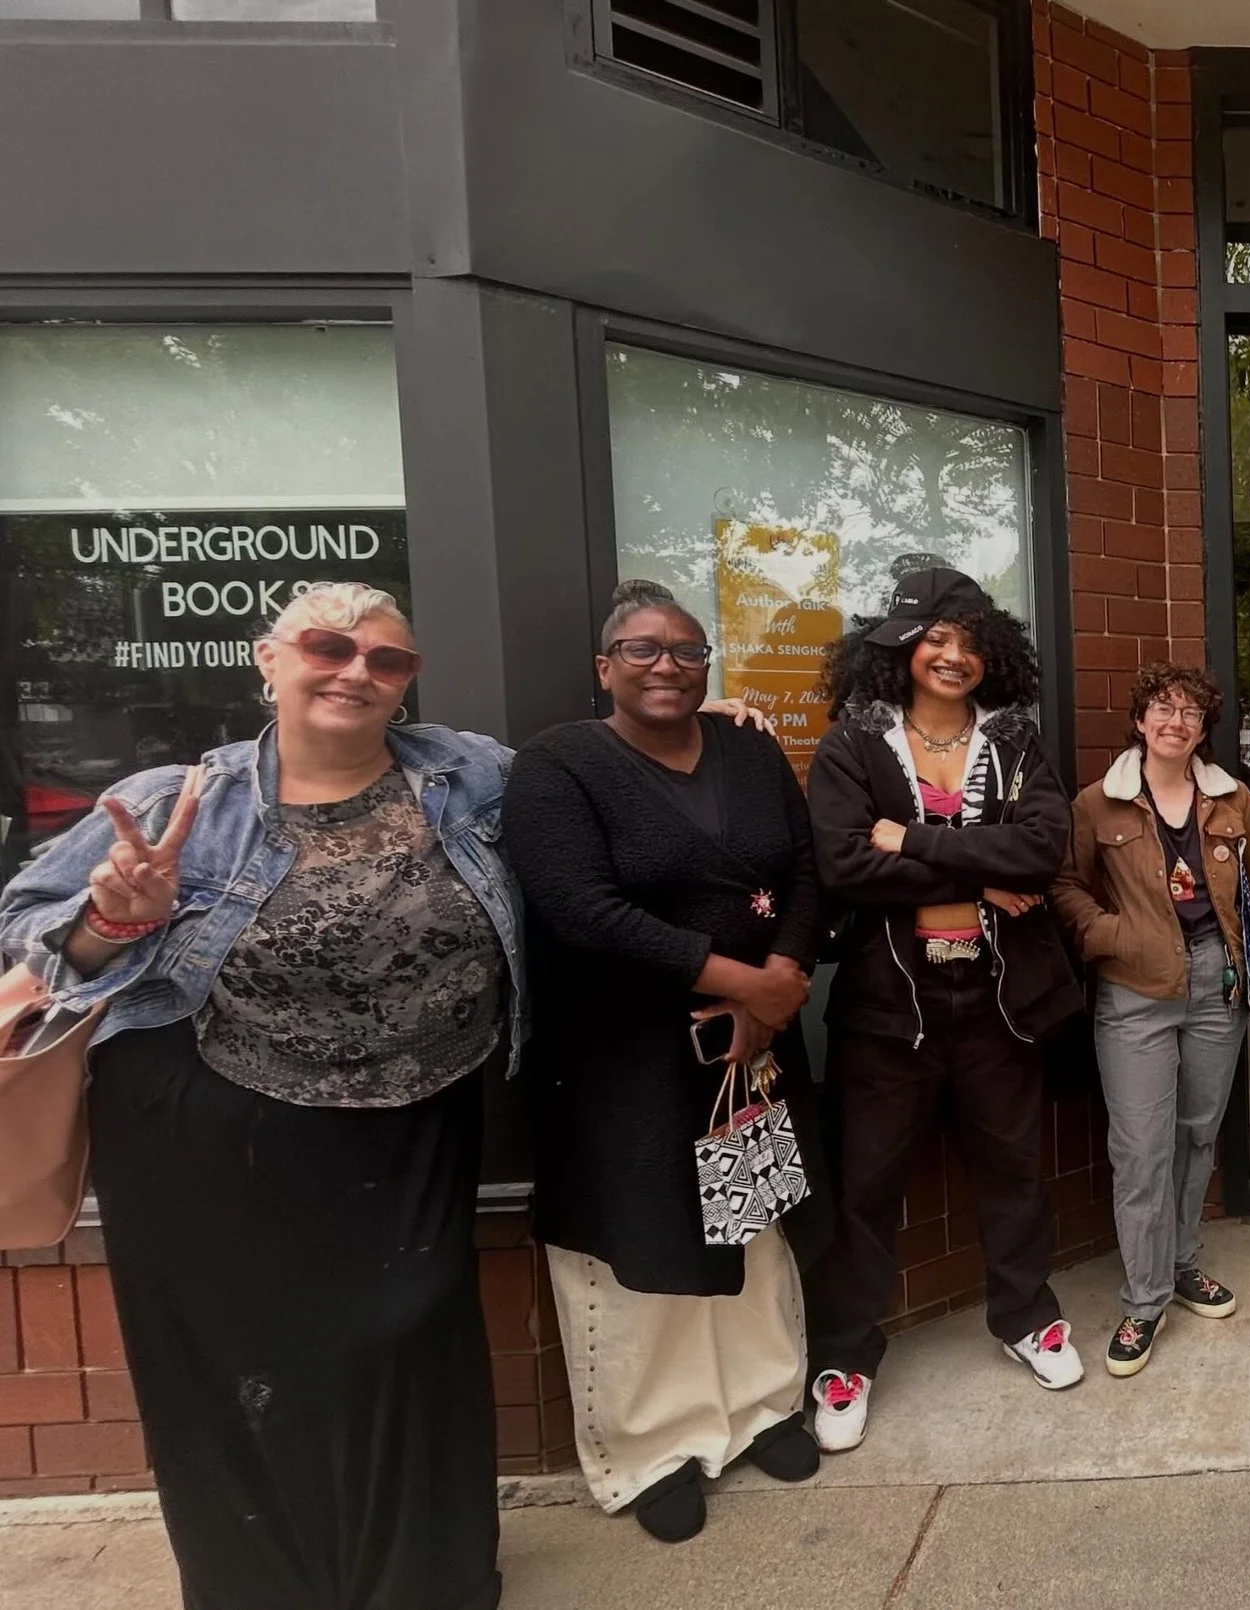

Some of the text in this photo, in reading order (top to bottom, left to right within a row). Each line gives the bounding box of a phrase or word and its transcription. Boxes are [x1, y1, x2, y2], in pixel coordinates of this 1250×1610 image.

[71, 525, 380, 564] UNDERGROUND
[735, 593, 790, 608] Author
[114, 640, 256, 668] #FINDYOUR
[728, 642, 774, 654] SHAKA
[742, 686, 778, 710] May
[782, 713, 808, 727] PM
